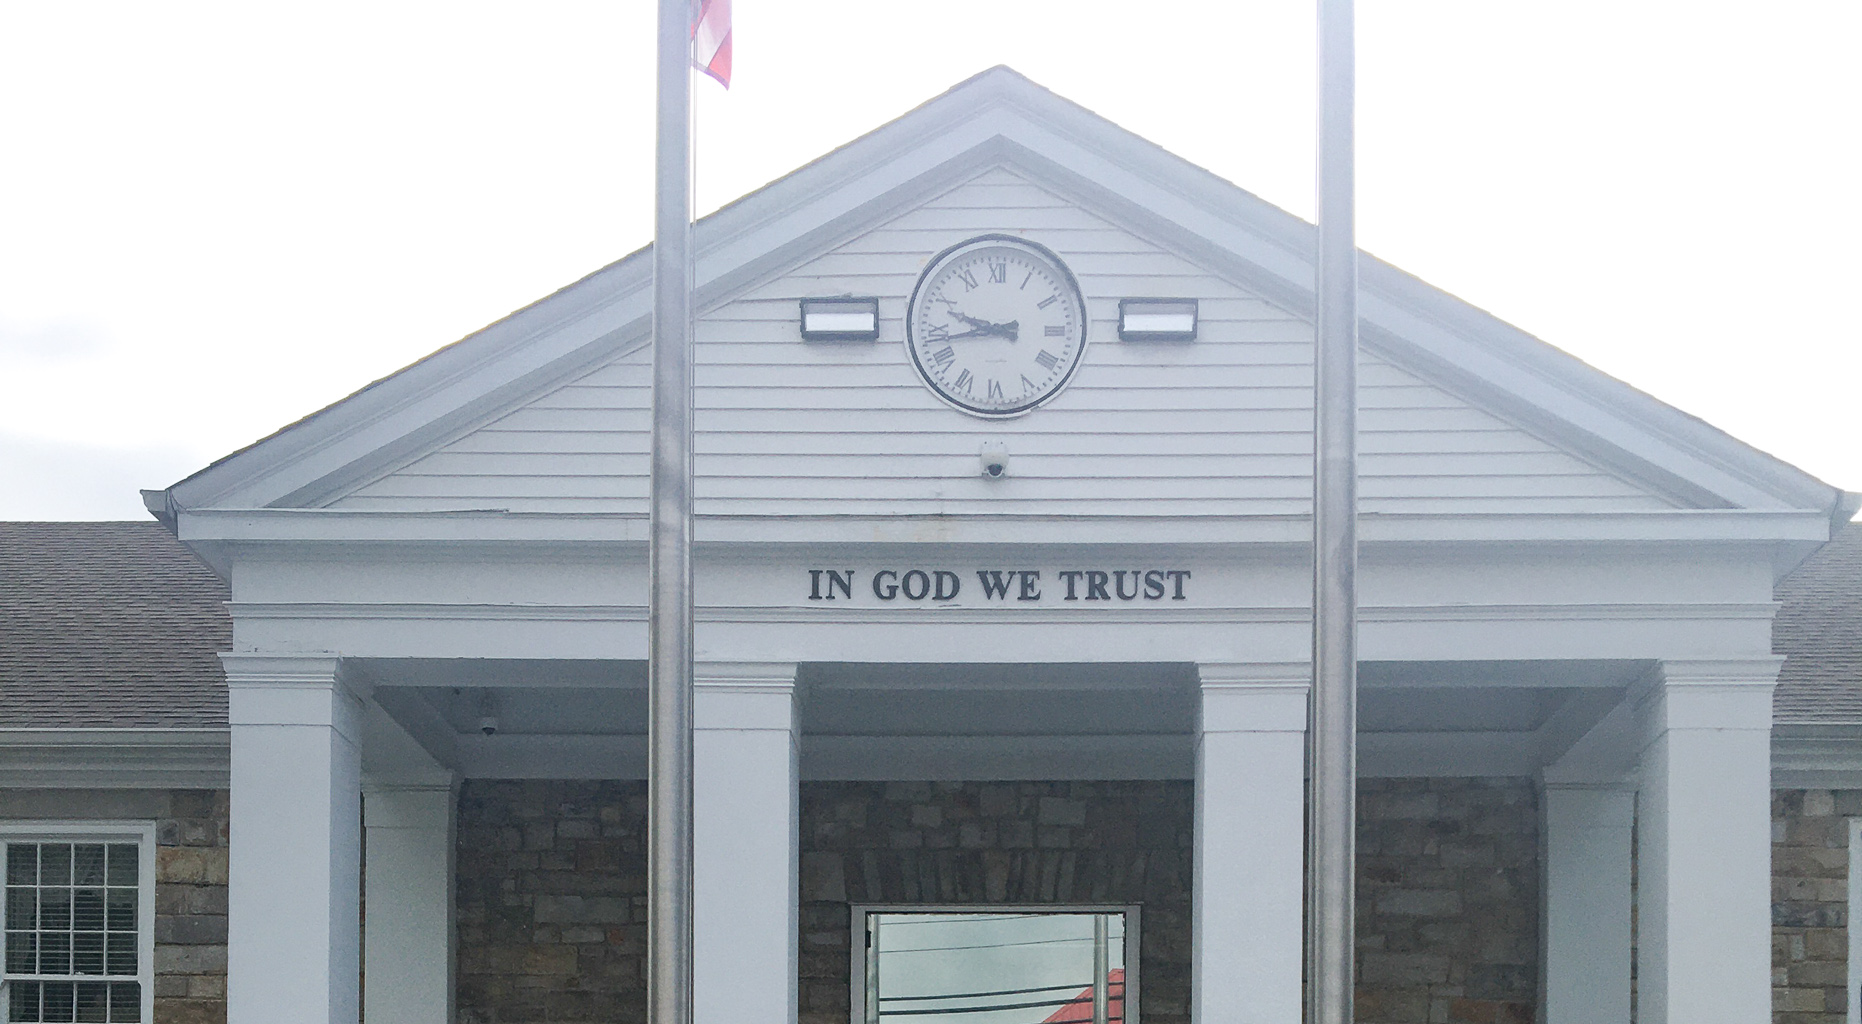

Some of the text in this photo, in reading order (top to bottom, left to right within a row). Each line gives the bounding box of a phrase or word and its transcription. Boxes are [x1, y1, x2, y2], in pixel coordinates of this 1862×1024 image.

[988, 263, 1006, 283] XII
[1044, 325, 1065, 337] III
[988, 379, 1003, 398] VI
[808, 569, 1191, 600] IN GOD WE TRUST
